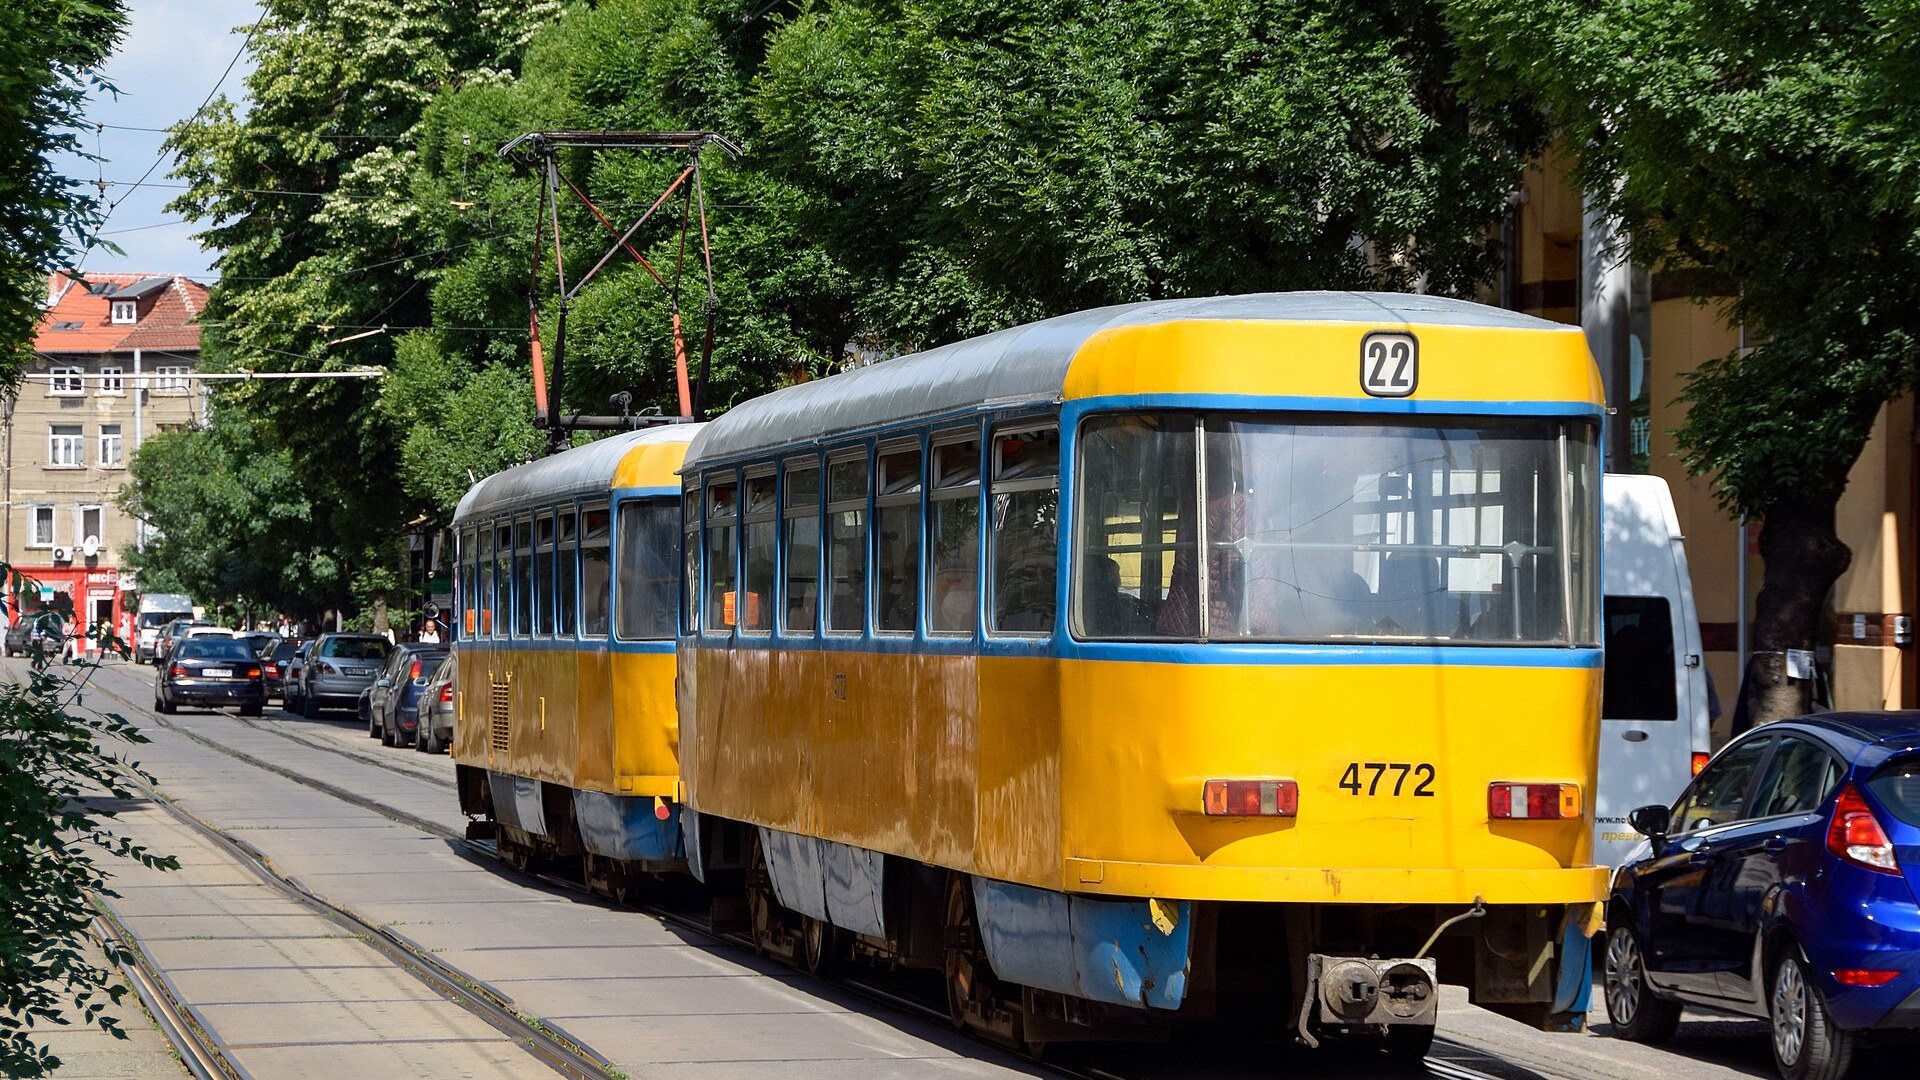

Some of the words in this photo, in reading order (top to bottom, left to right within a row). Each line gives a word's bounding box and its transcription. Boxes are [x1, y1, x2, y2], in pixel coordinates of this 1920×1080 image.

[1368, 341, 1410, 387] 22
[88, 573, 108, 584] МЕС
[1338, 762, 1436, 797] 4772
